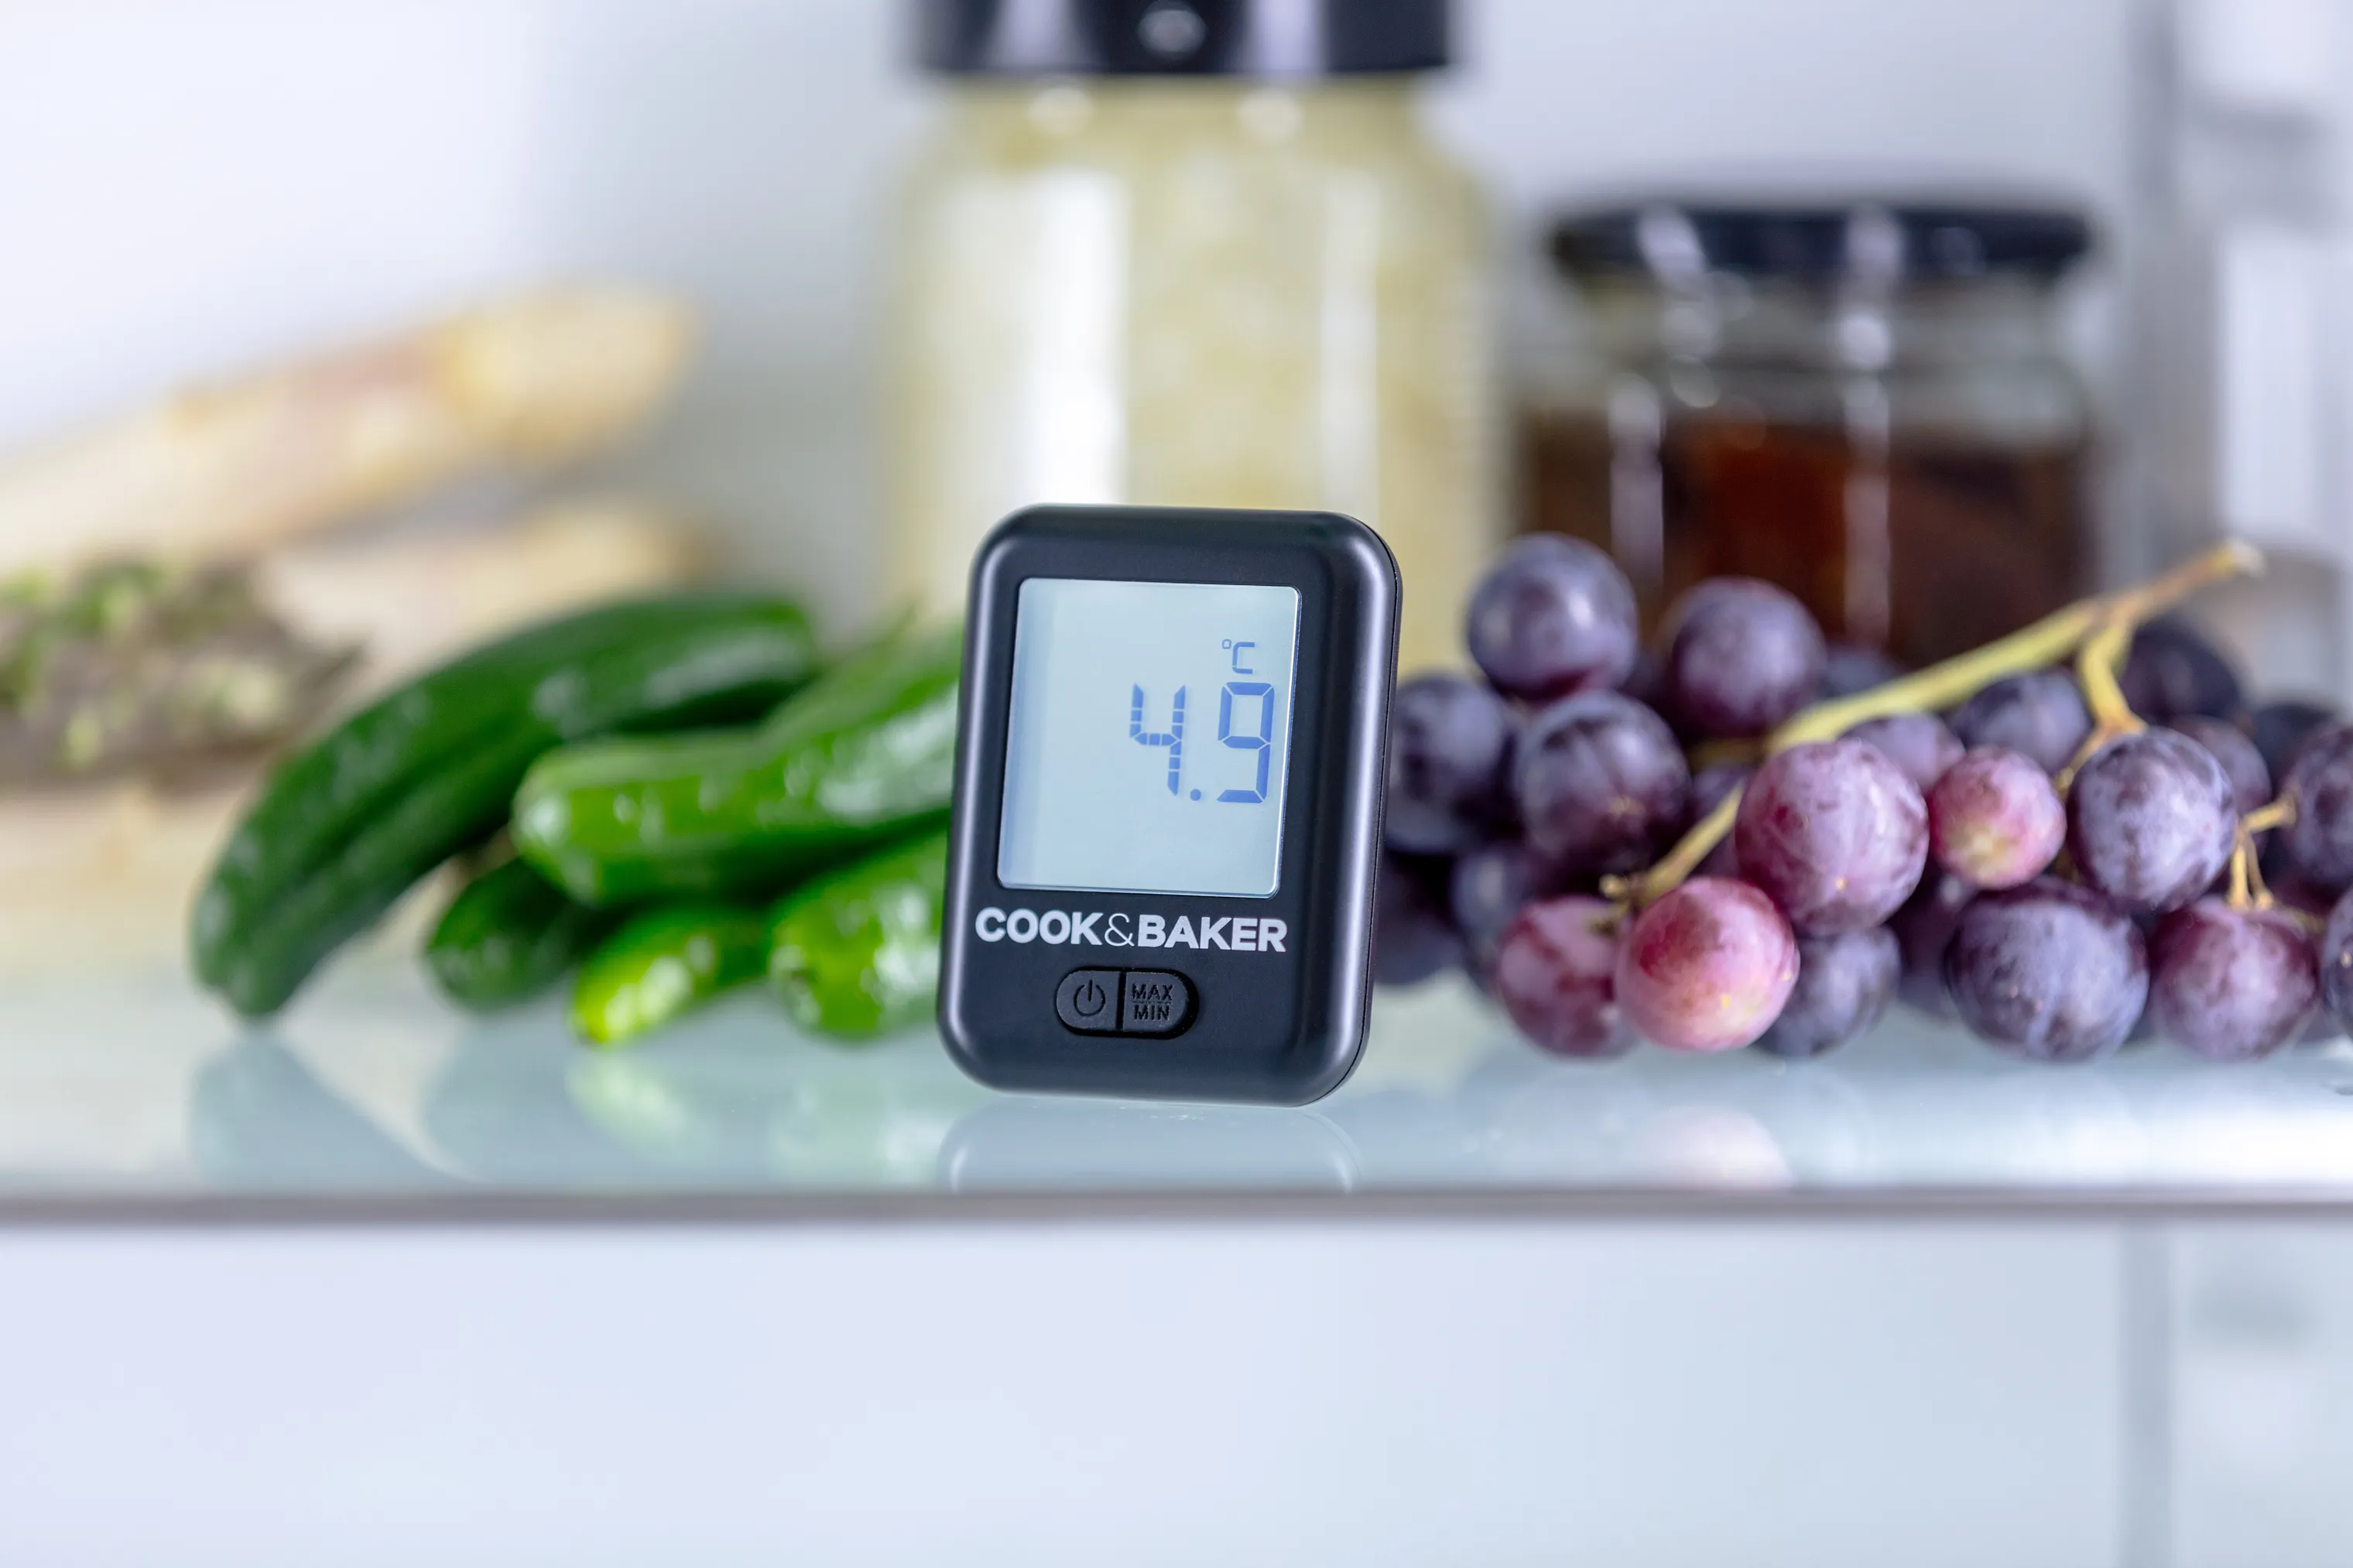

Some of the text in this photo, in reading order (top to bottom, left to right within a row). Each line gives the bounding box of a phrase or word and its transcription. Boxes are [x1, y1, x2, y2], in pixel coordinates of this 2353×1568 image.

[1129, 682, 1275, 803] 4.9
[974, 906, 1288, 953] COOK&BAKER
[1132, 983, 1173, 1001] MAX
[1133, 1005, 1170, 1021] MIN
